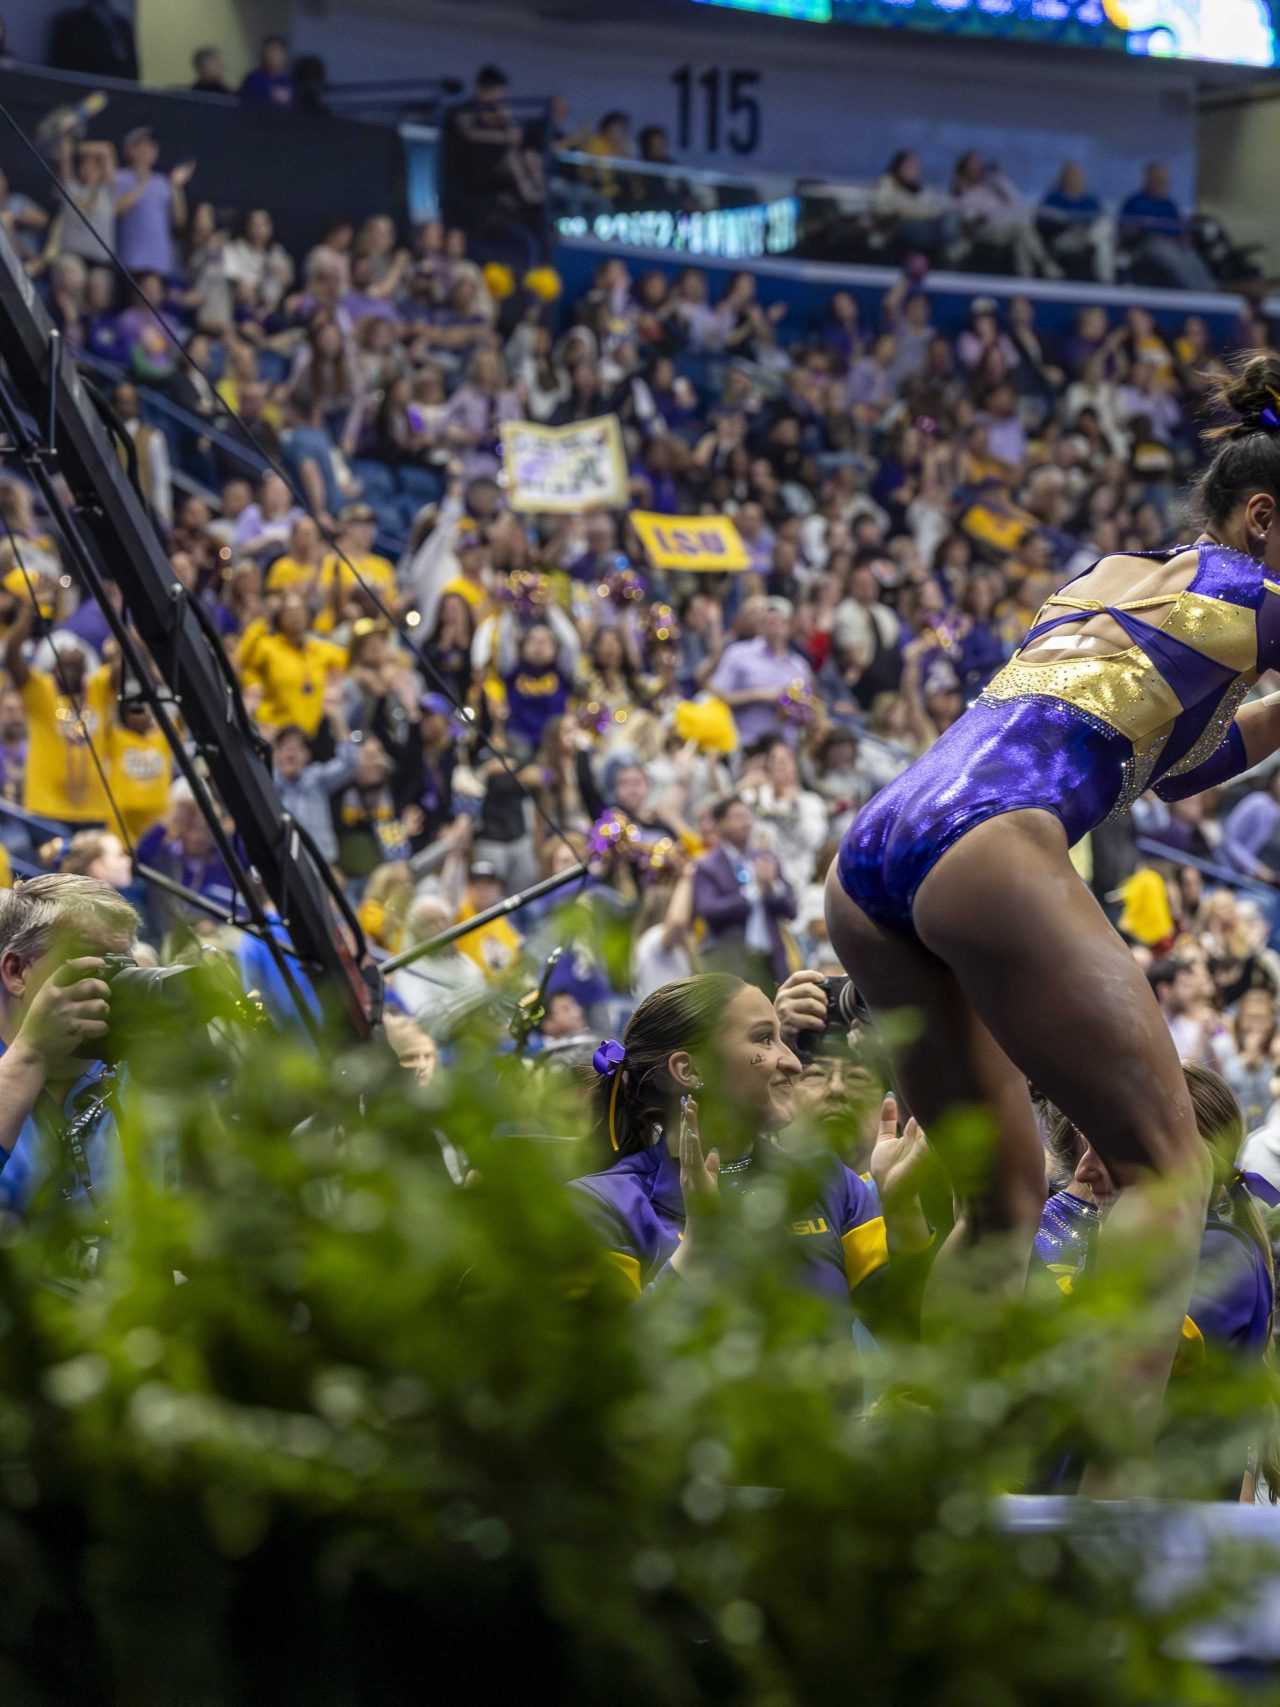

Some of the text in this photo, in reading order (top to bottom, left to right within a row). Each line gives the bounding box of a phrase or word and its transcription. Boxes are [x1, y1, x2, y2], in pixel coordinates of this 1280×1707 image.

[670, 64, 761, 154] 115
[653, 523, 727, 556] LSU
[791, 1217, 828, 1235] SU
